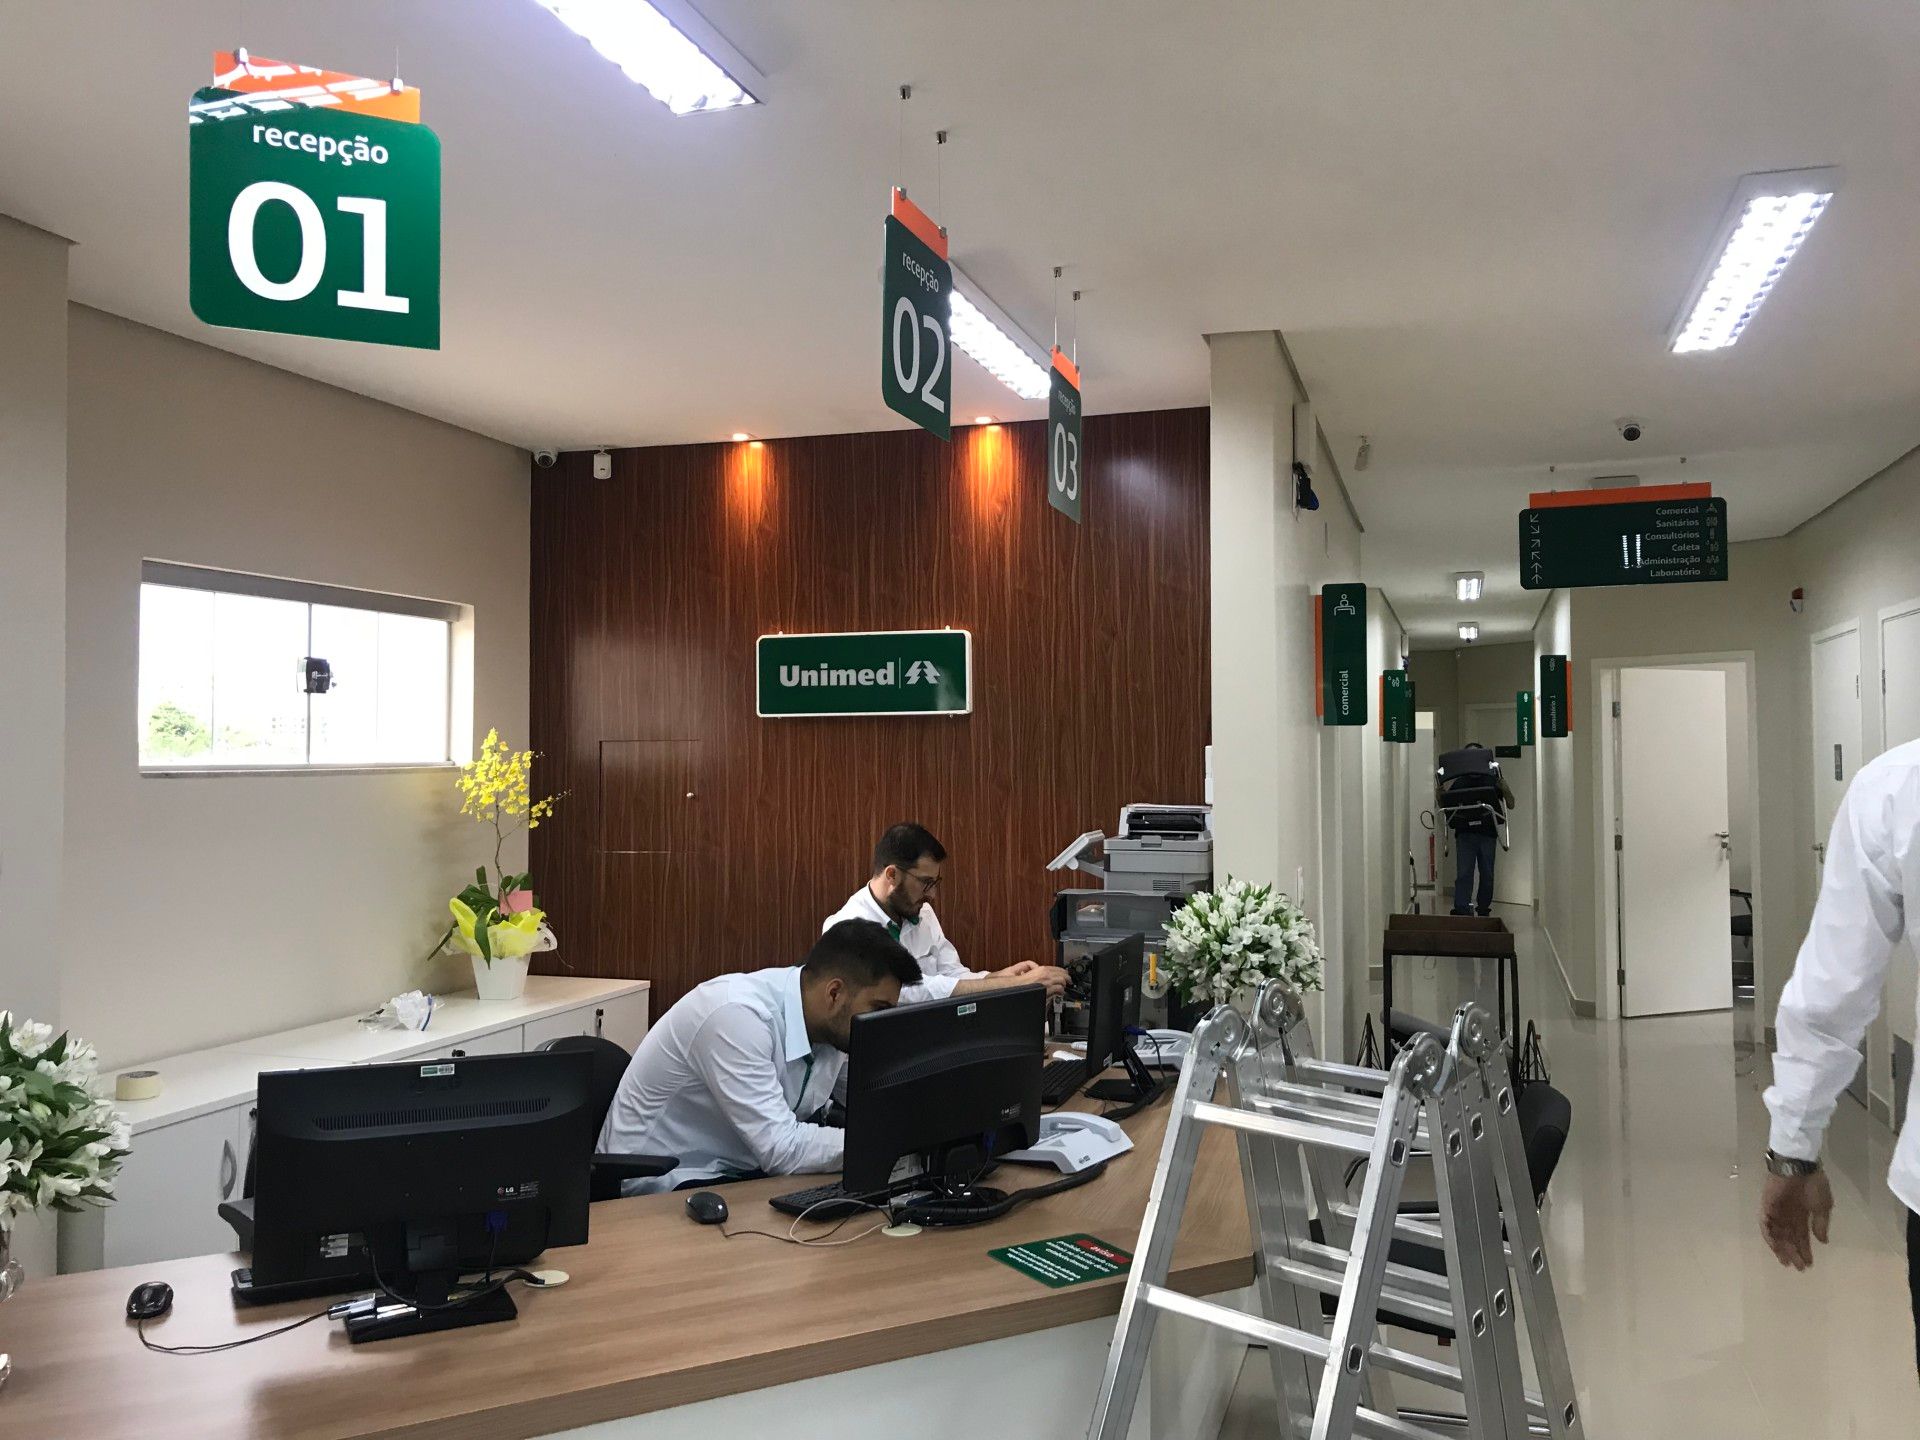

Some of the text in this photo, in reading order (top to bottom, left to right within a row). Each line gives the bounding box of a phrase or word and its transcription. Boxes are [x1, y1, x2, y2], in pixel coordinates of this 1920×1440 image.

[253, 123, 389, 166] recepção
[228, 180, 411, 315] 01
[902, 251, 939, 293] recepção
[893, 296, 945, 414] 02
[1054, 422, 1078, 501] 03
[1655, 506, 1699, 515] Comercial
[1656, 519, 1700, 528] Sanitários
[1645, 531, 1700, 540] Consultórios
[1671, 543, 1700, 552] Coleta
[1650, 568, 1700, 577] Laboratório
[779, 661, 894, 687] Unimed
[1339, 669, 1349, 715] comercial
